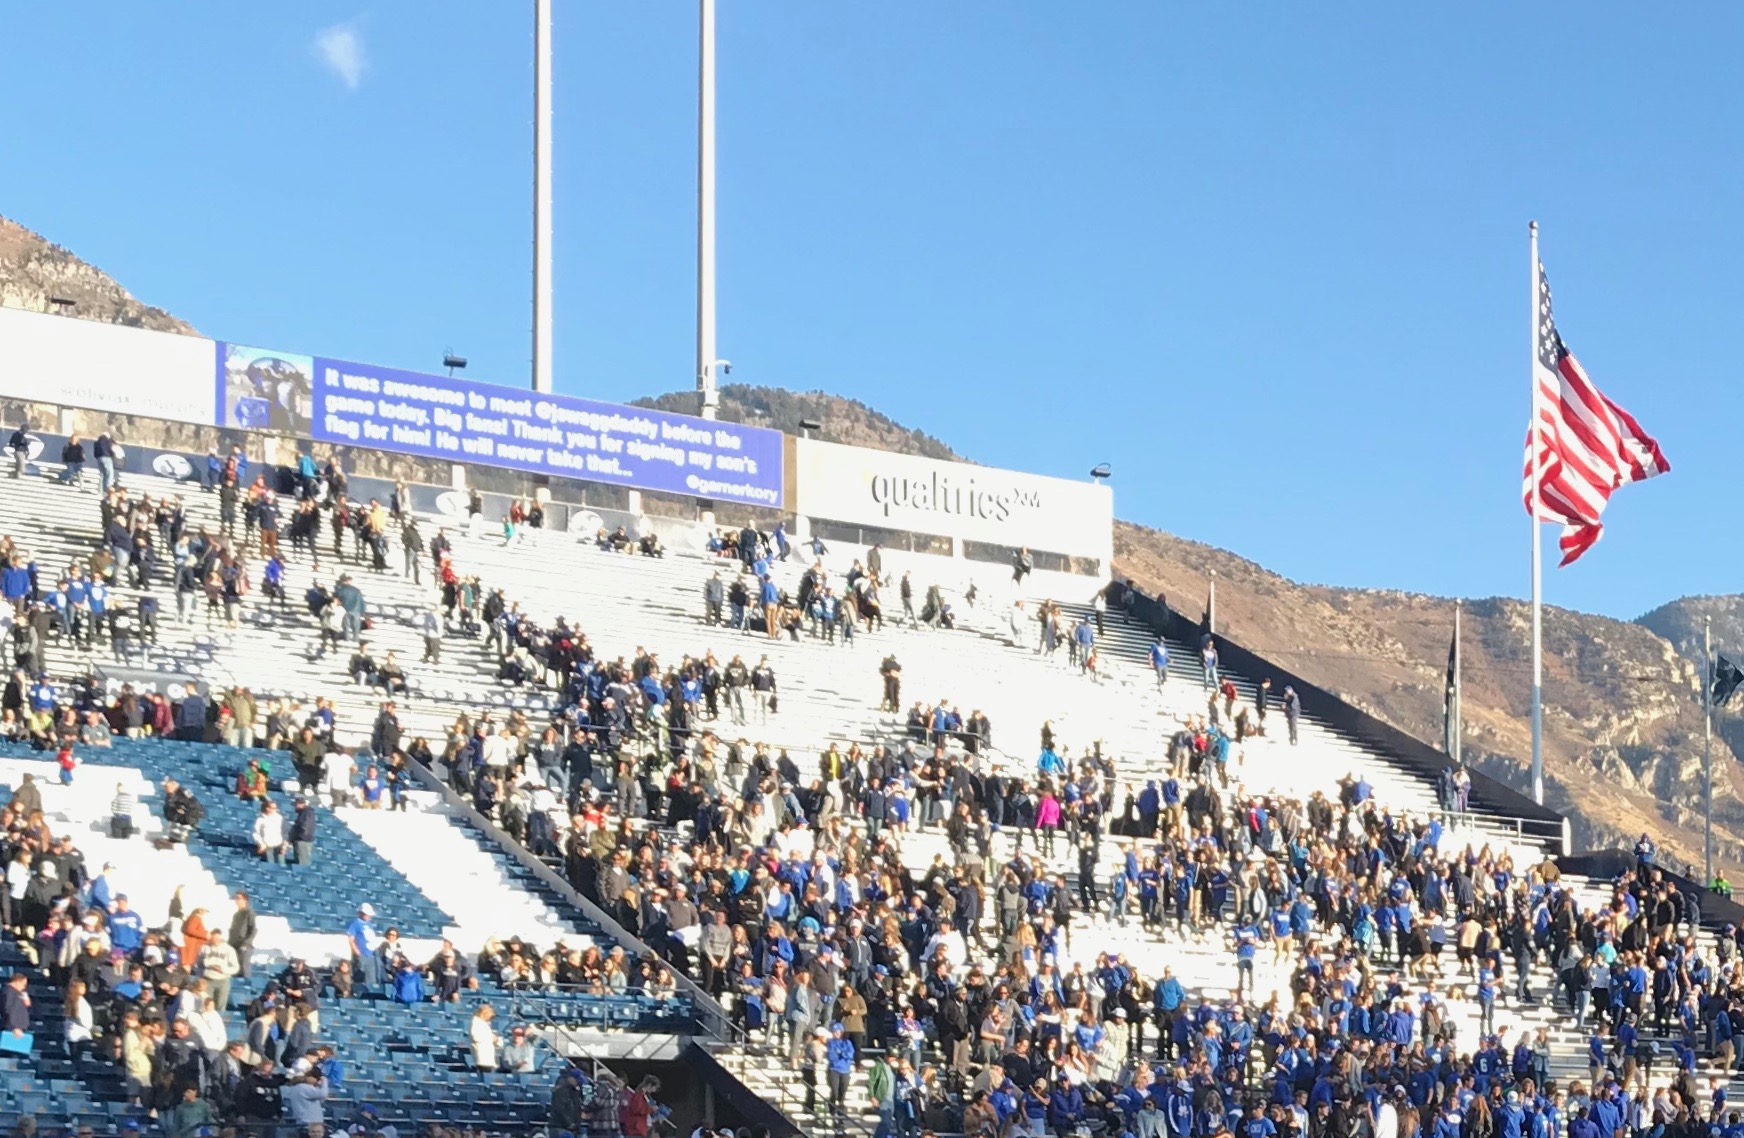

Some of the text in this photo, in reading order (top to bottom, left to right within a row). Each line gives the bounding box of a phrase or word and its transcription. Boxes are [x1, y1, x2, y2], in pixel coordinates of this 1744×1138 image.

[324, 414, 360, 440] flag
[363, 419, 390, 441] for
[392, 424, 431, 447] him!
[435, 430, 460, 451] He
[462, 436, 494, 457] will
[497, 442, 545, 465] never
[546, 448, 584, 471] take
[325, 367, 340, 387] It
[343, 373, 380, 394] was
[383, 379, 466, 407] awesome
[469, 390, 487, 410] to
[489, 396, 532, 417] meet
[661, 420, 713, 446] before
[715, 429, 742, 450] the
[325, 394, 758, 475] game today. Big fans! Thank you for signing my son's
